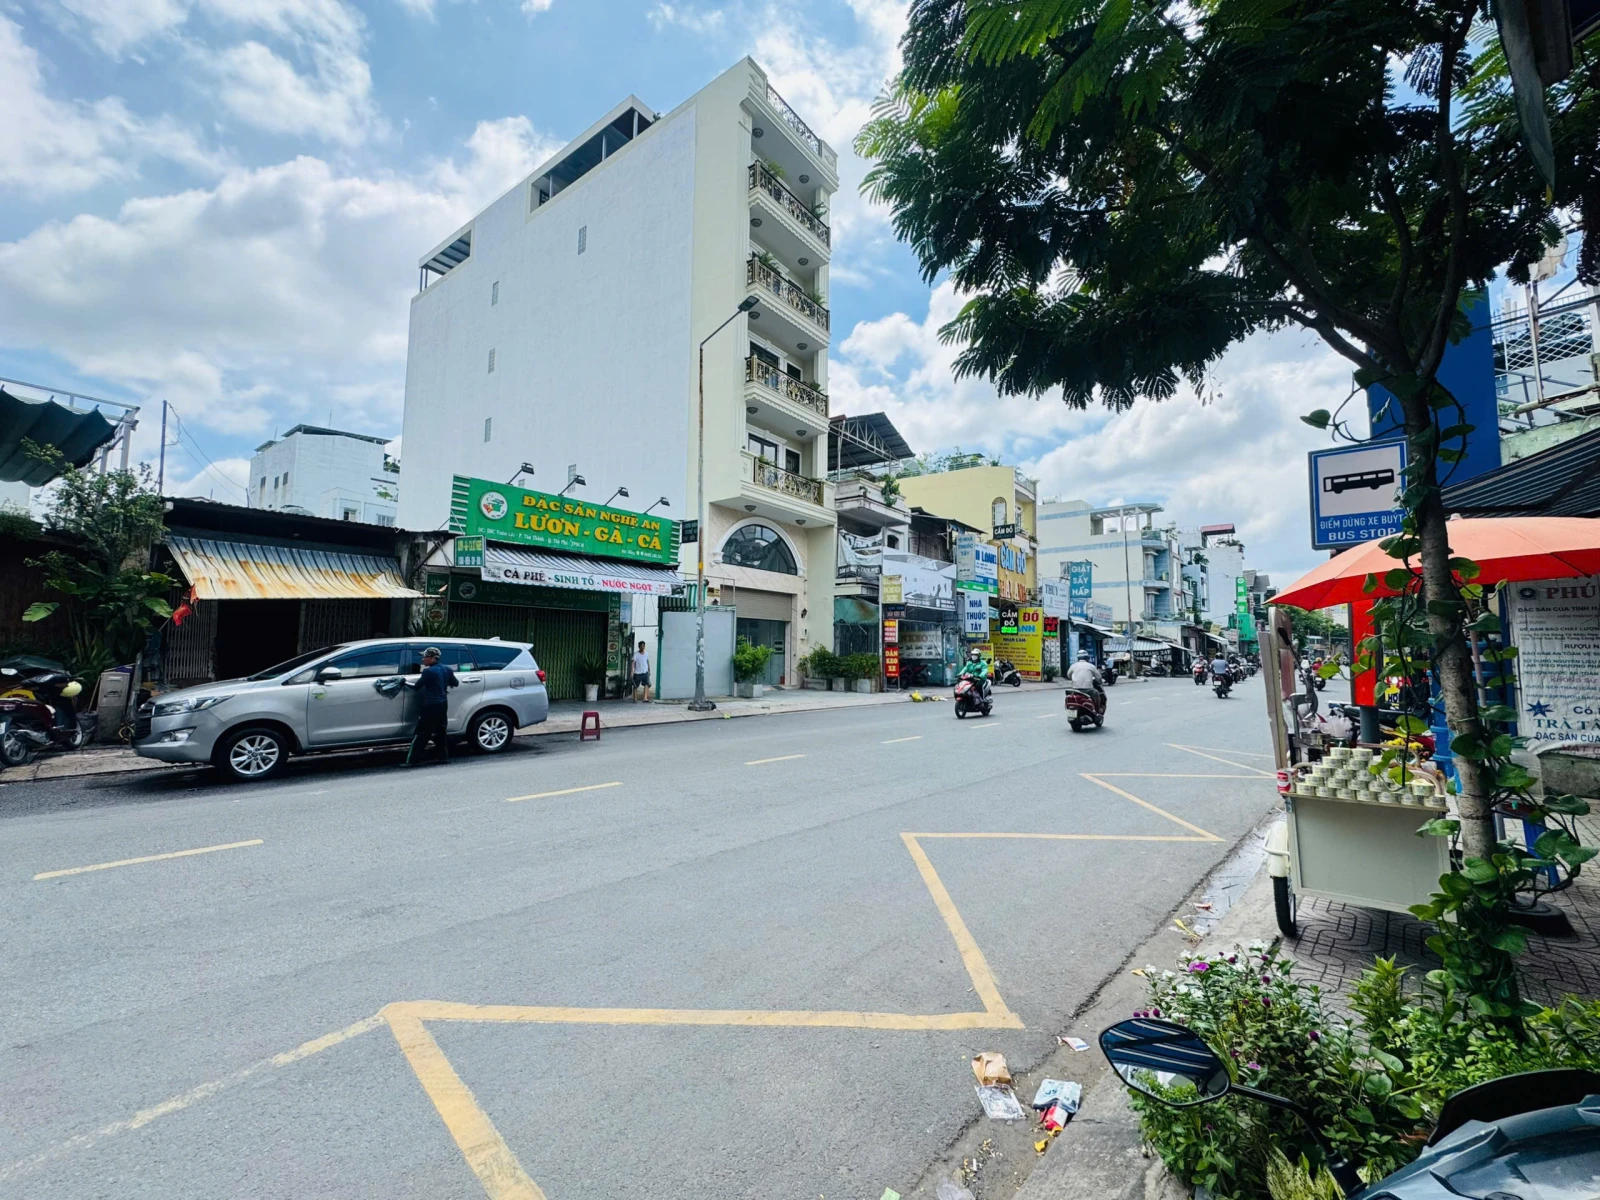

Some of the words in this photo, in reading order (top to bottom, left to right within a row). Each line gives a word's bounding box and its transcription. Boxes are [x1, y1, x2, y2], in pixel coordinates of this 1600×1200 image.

[522, 495, 561, 512] ĐẶC
[563, 500, 597, 519] SẢN
[599, 510, 639, 529] NGHỆ
[641, 519, 661, 530] AN
[1320, 517, 1340, 529] ĐIỂM
[1342, 516, 1366, 528] DỪNG
[1368, 516, 1379, 526] XE
[1381, 512, 1404, 524] BUÝT
[514, 511, 580, 537] LƯƠN
[594, 524, 624, 544] GÀ
[637, 532, 662, 550] CÁ
[1328, 530, 1355, 541] BUS
[1360, 527, 1396, 539] STOP
[503, 568, 520, 579] CÀ
[523, 570, 546, 582] PHÊ
[554, 574, 579, 585] SINH
[582, 574, 595, 586] TỐ
[602, 577, 627, 590] NƯỚC
[629, 582, 653, 592] NGỌT
[1072, 574, 1089, 584] SẤY
[1071, 586, 1090, 596] HẤP
[1545, 582, 1596, 600] PHÚ
[969, 598, 983, 608] NHÀ
[966, 610, 987, 620] THUỐC
[1001, 609, 1018, 618] CẦM
[1022, 608, 1039, 622] ĐỒ
[970, 623, 982, 631] TÂY
[1573, 705, 1594, 715] Có
[1533, 716, 1573, 730] TRÀ
[1535, 731, 1556, 742] ĐẶC
[1558, 731, 1578, 741] SẢN
